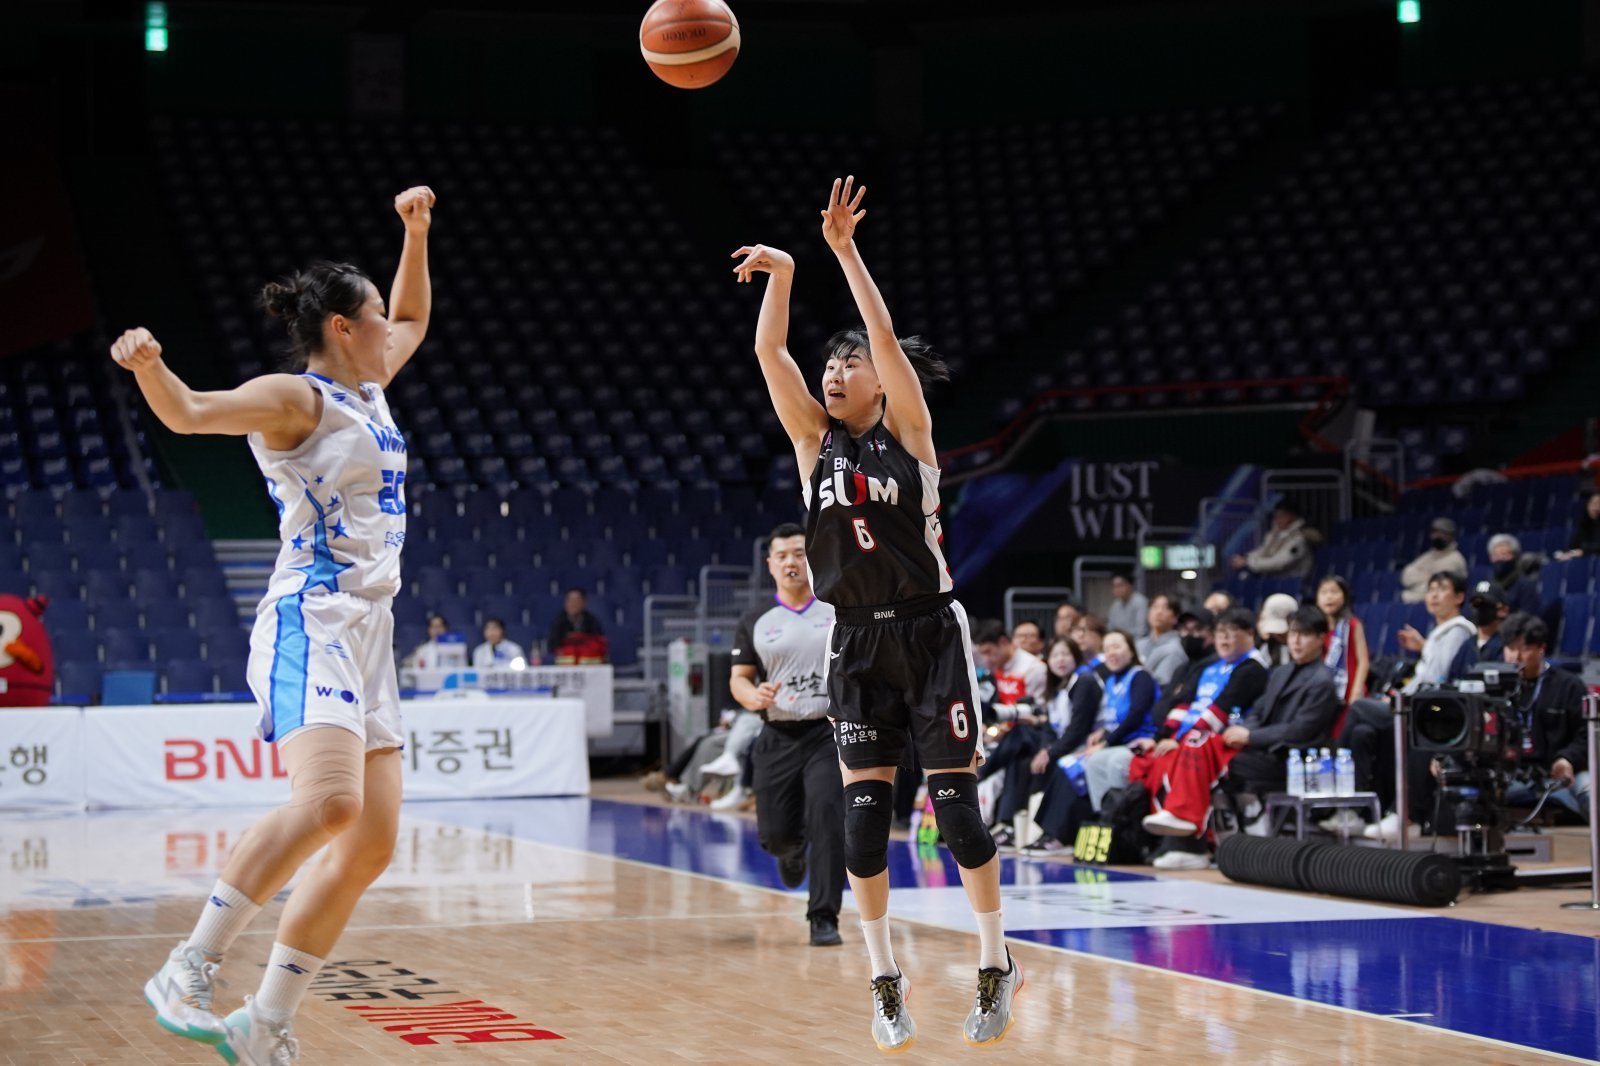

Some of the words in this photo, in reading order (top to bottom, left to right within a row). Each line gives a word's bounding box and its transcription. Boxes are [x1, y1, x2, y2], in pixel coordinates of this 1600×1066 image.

[818, 470, 899, 511] SUM
[1071, 461, 1159, 503] JUST
[852, 516, 876, 553] 6
[1069, 502, 1154, 540] WIN
[874, 610, 896, 620] BNK
[949, 700, 969, 742] 6
[0, 744, 49, 786] 행
